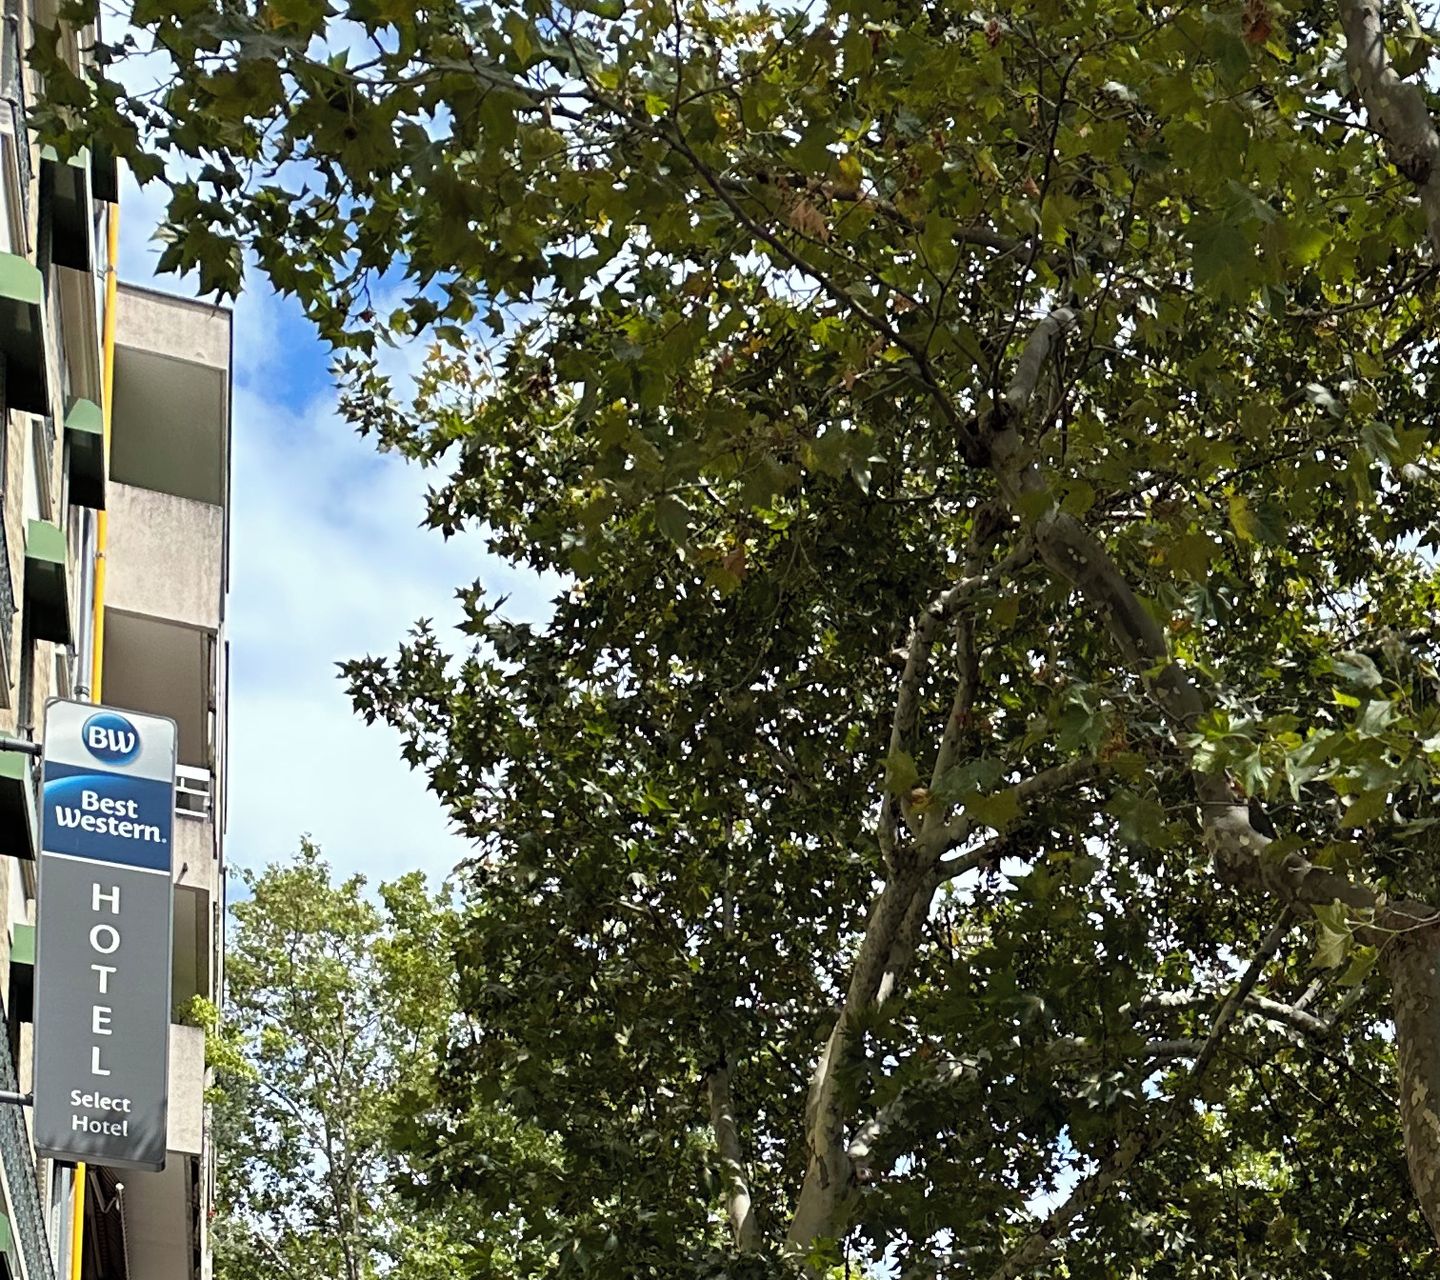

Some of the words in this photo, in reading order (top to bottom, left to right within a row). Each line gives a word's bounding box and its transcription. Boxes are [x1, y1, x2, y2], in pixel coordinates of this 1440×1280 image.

[88, 726, 135, 754] BW
[81, 790, 139, 819] Best
[89, 882, 121, 1076] HOTEL
[70, 1089, 131, 1113] Select
[71, 1114, 129, 1137] Hotel
